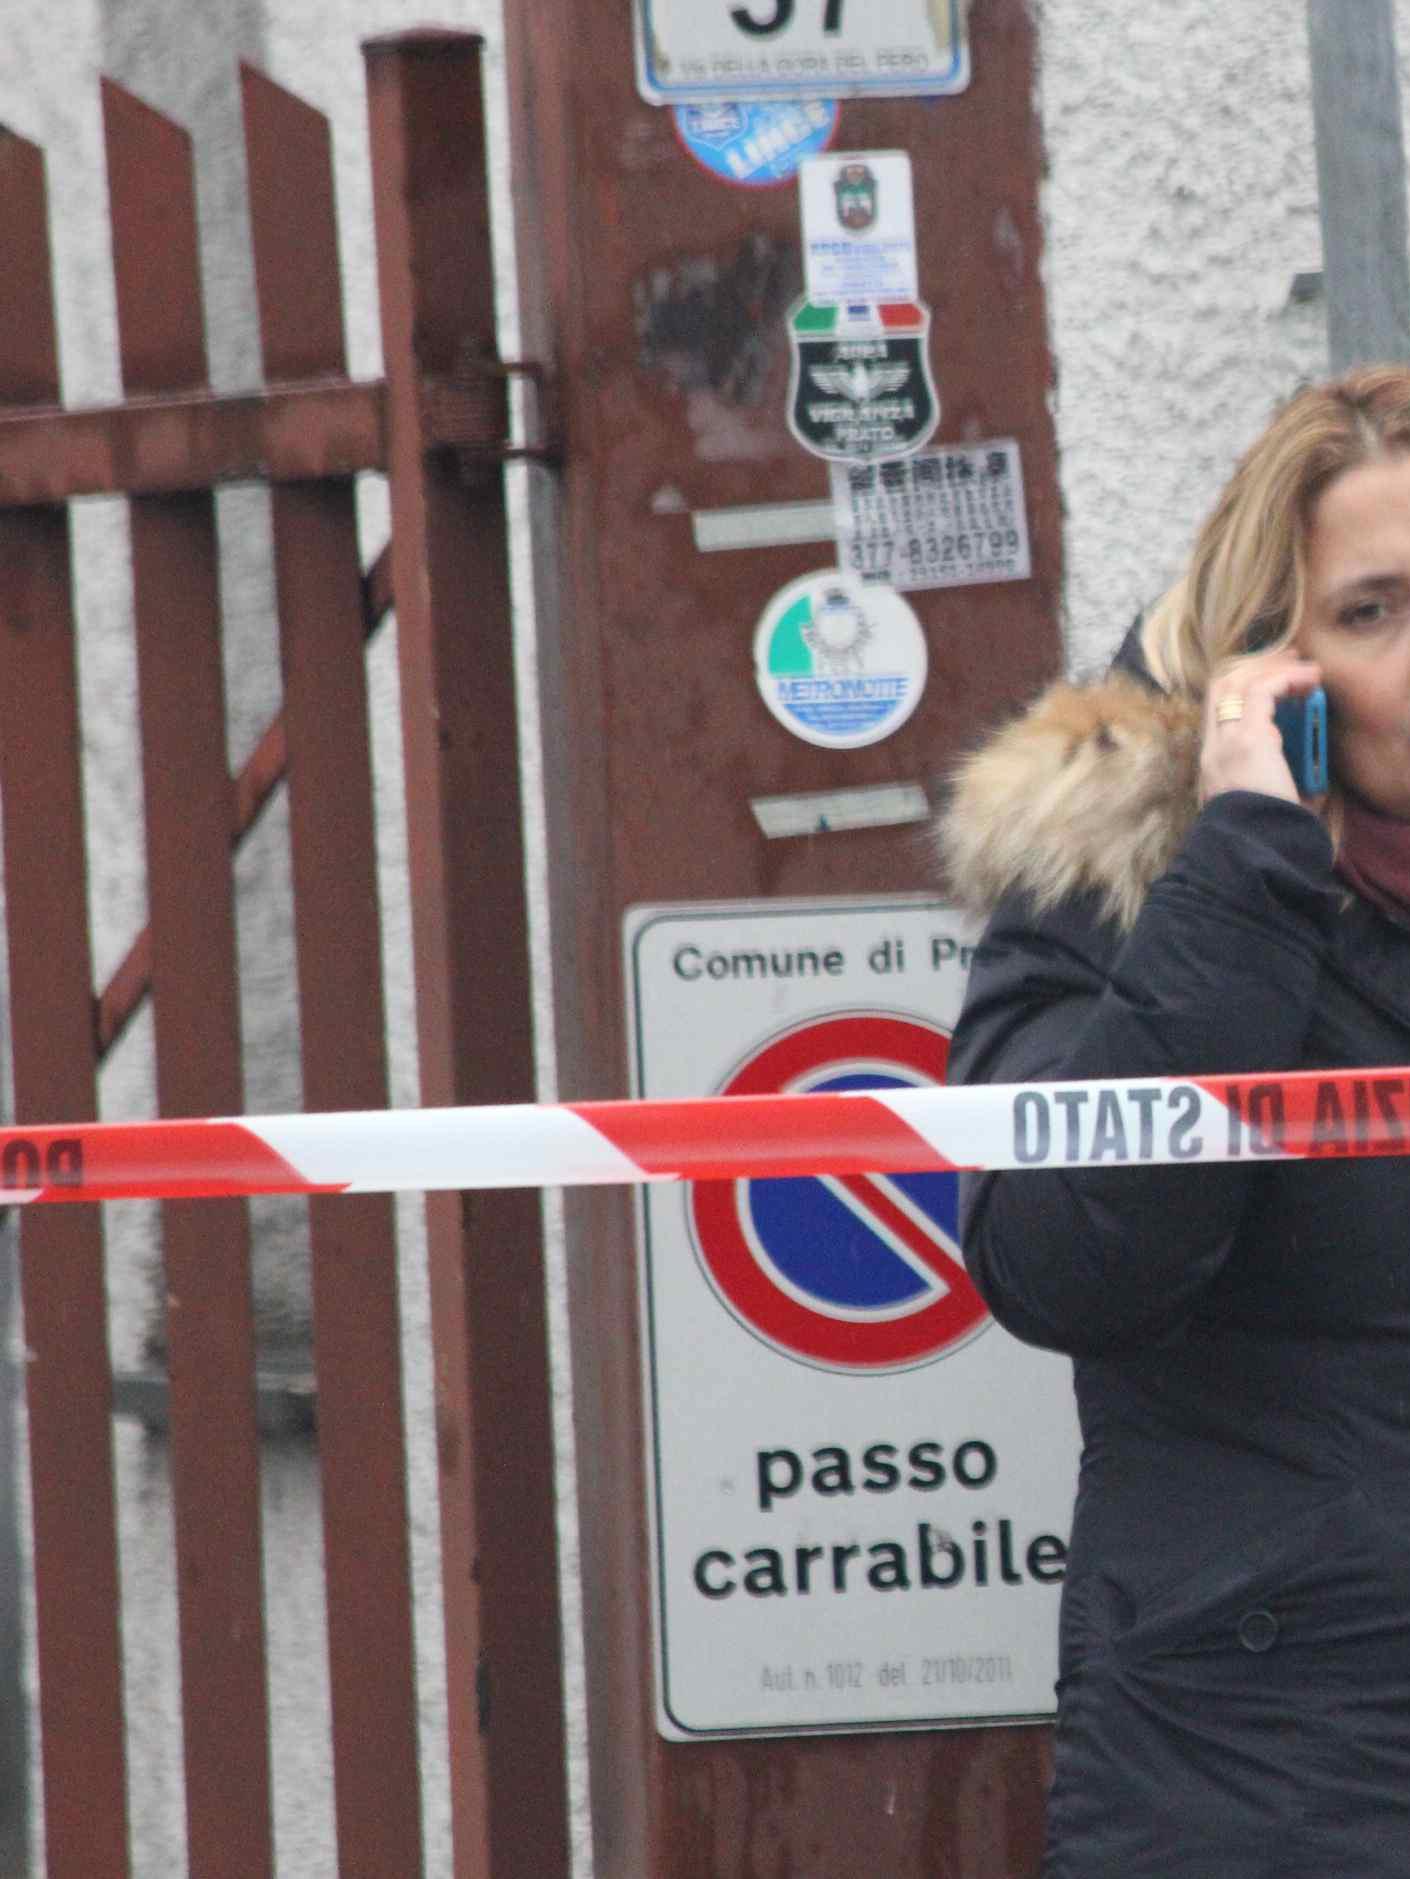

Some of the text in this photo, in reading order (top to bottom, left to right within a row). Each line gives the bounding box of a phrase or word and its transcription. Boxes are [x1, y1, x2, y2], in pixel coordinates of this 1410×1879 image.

[672, 937, 979, 981] Comune di Pr
[757, 1439, 997, 1512] passo
[693, 1519, 1067, 1599] carrabile
